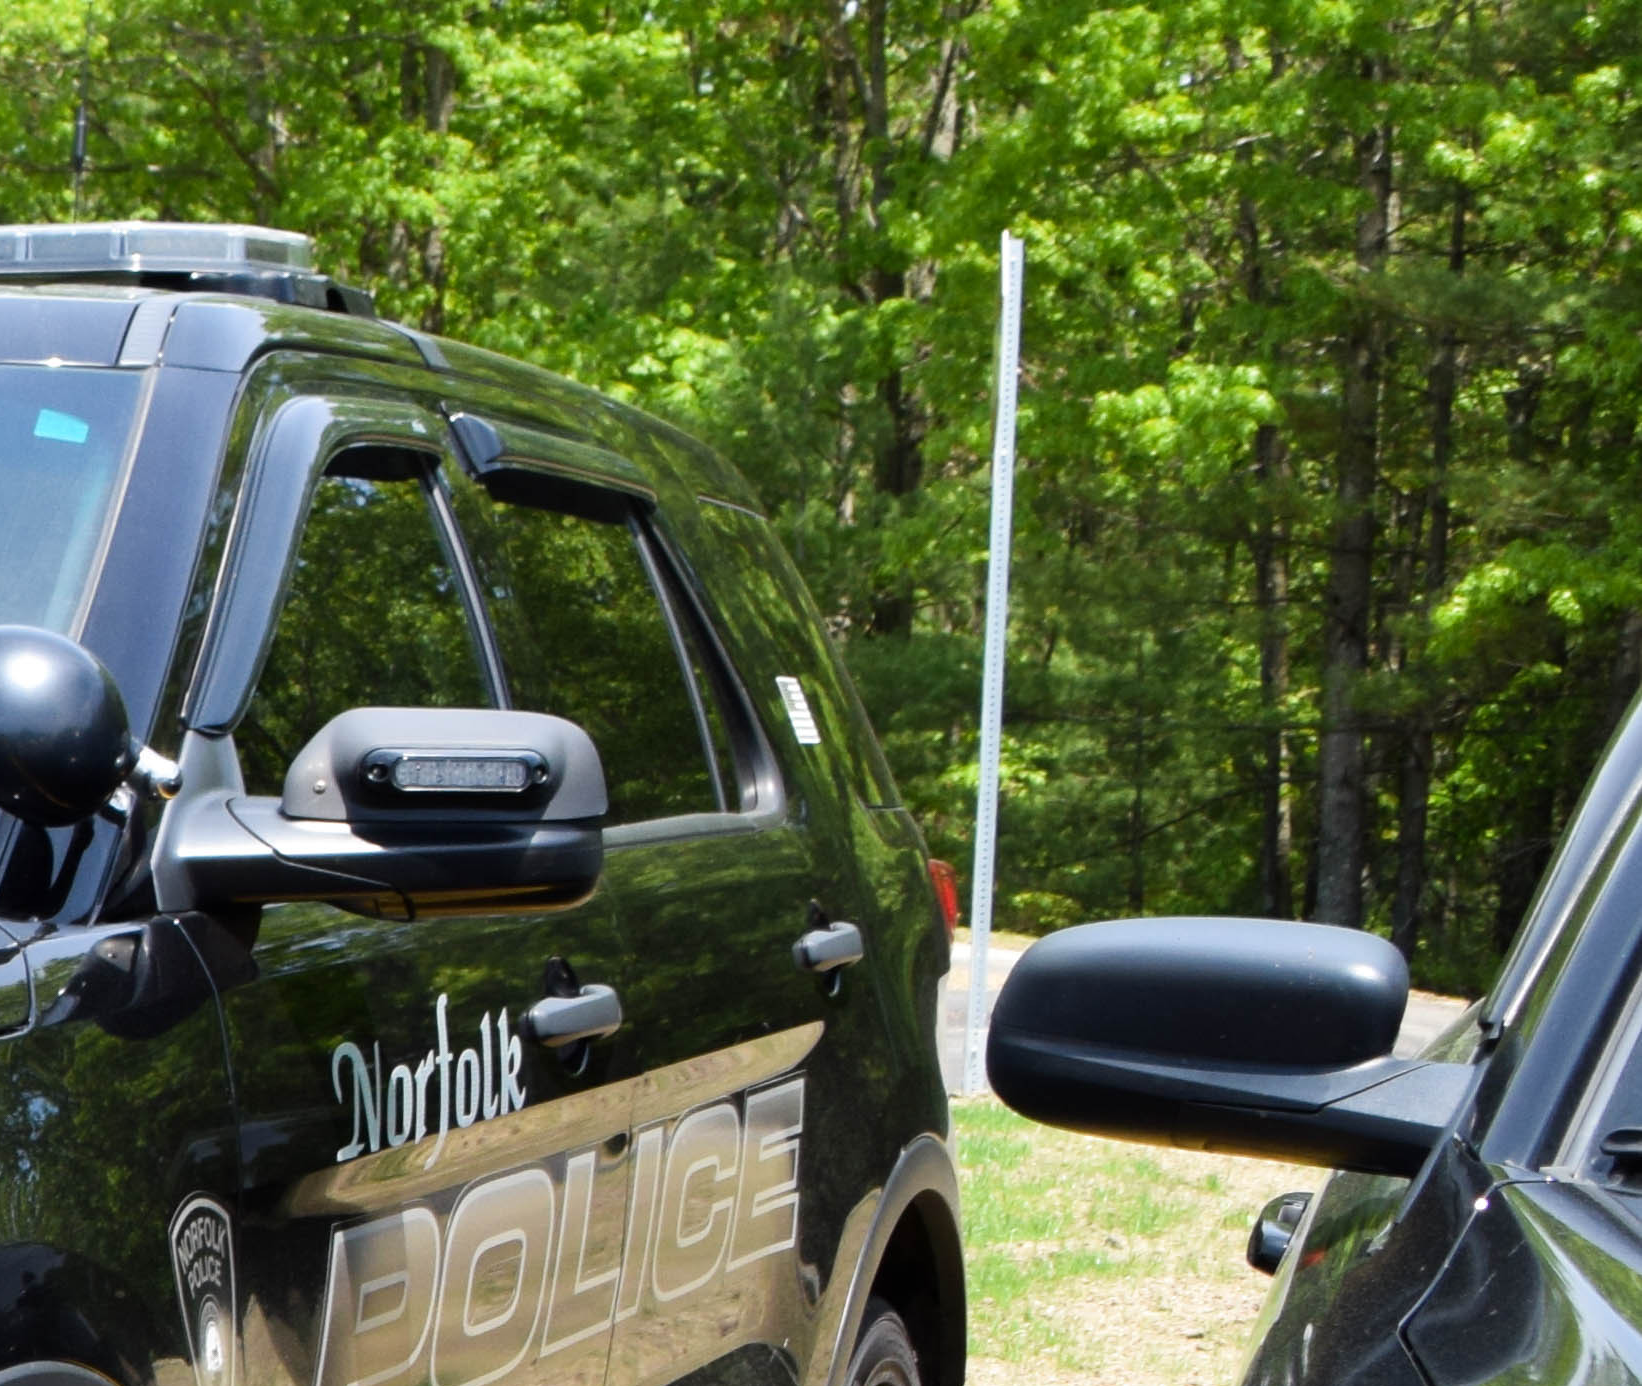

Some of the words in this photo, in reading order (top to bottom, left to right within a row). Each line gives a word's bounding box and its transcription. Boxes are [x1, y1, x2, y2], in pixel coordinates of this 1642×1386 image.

[331, 992, 527, 1170] Norfolk
[178, 1216, 226, 1275] NORFOLK
[188, 1254, 222, 1299] POLICE
